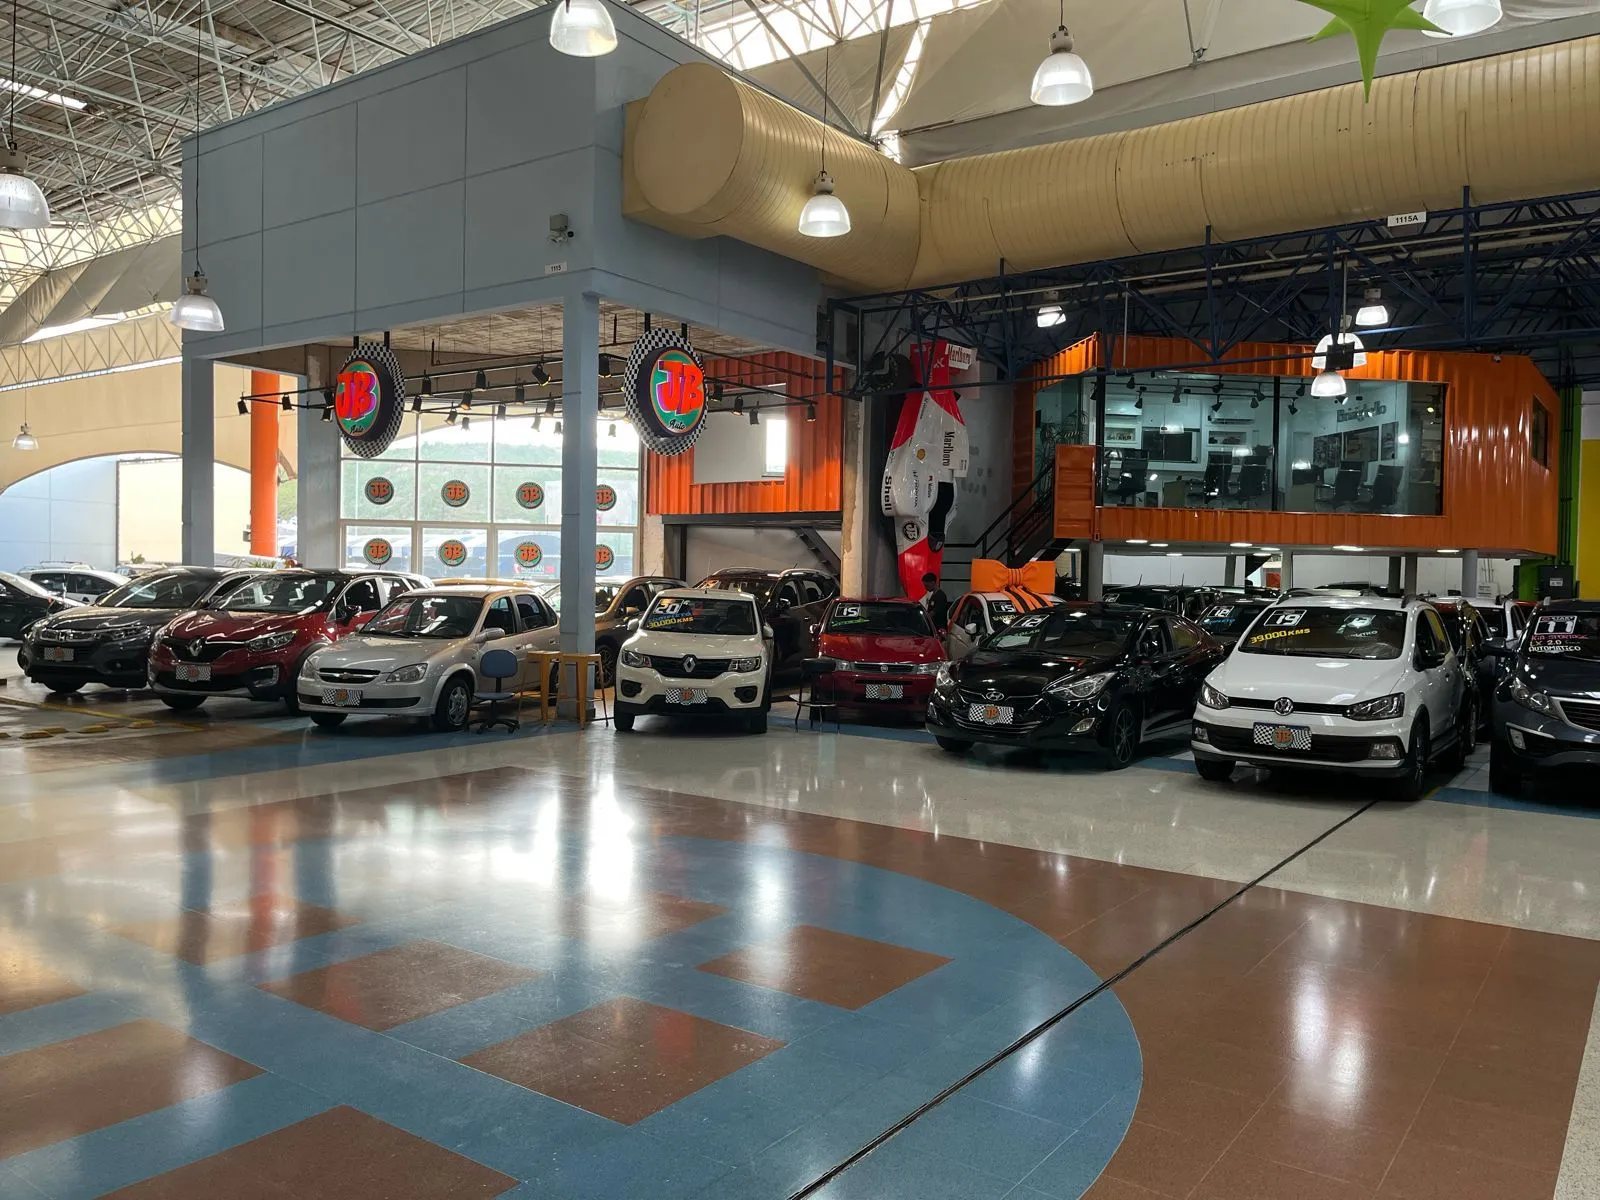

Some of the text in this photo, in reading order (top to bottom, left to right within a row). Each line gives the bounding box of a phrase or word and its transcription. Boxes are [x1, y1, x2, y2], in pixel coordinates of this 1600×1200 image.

[1395, 215, 1418, 224] 1115A
[336, 371, 377, 422] JB
[656, 360, 704, 416] JB
[942, 431, 955, 467] Marlboro
[370, 481, 390, 499] JB
[446, 483, 465, 501] JB
[521, 486, 540, 503] JB
[884, 475, 893, 511] Shell
[905, 523, 919, 541] JB
[368, 541, 388, 559] JB
[444, 543, 463, 561] JB
[520, 545, 539, 562] JB
[655, 603, 680, 614] 20
[843, 607, 858, 616] 15
[1001, 604, 1016, 612] 15
[1020, 618, 1042, 627] 12
[1276, 614, 1300, 625] 19
[1547, 621, 1574, 633] 11
[1288, 628, 1310, 636] KMS
